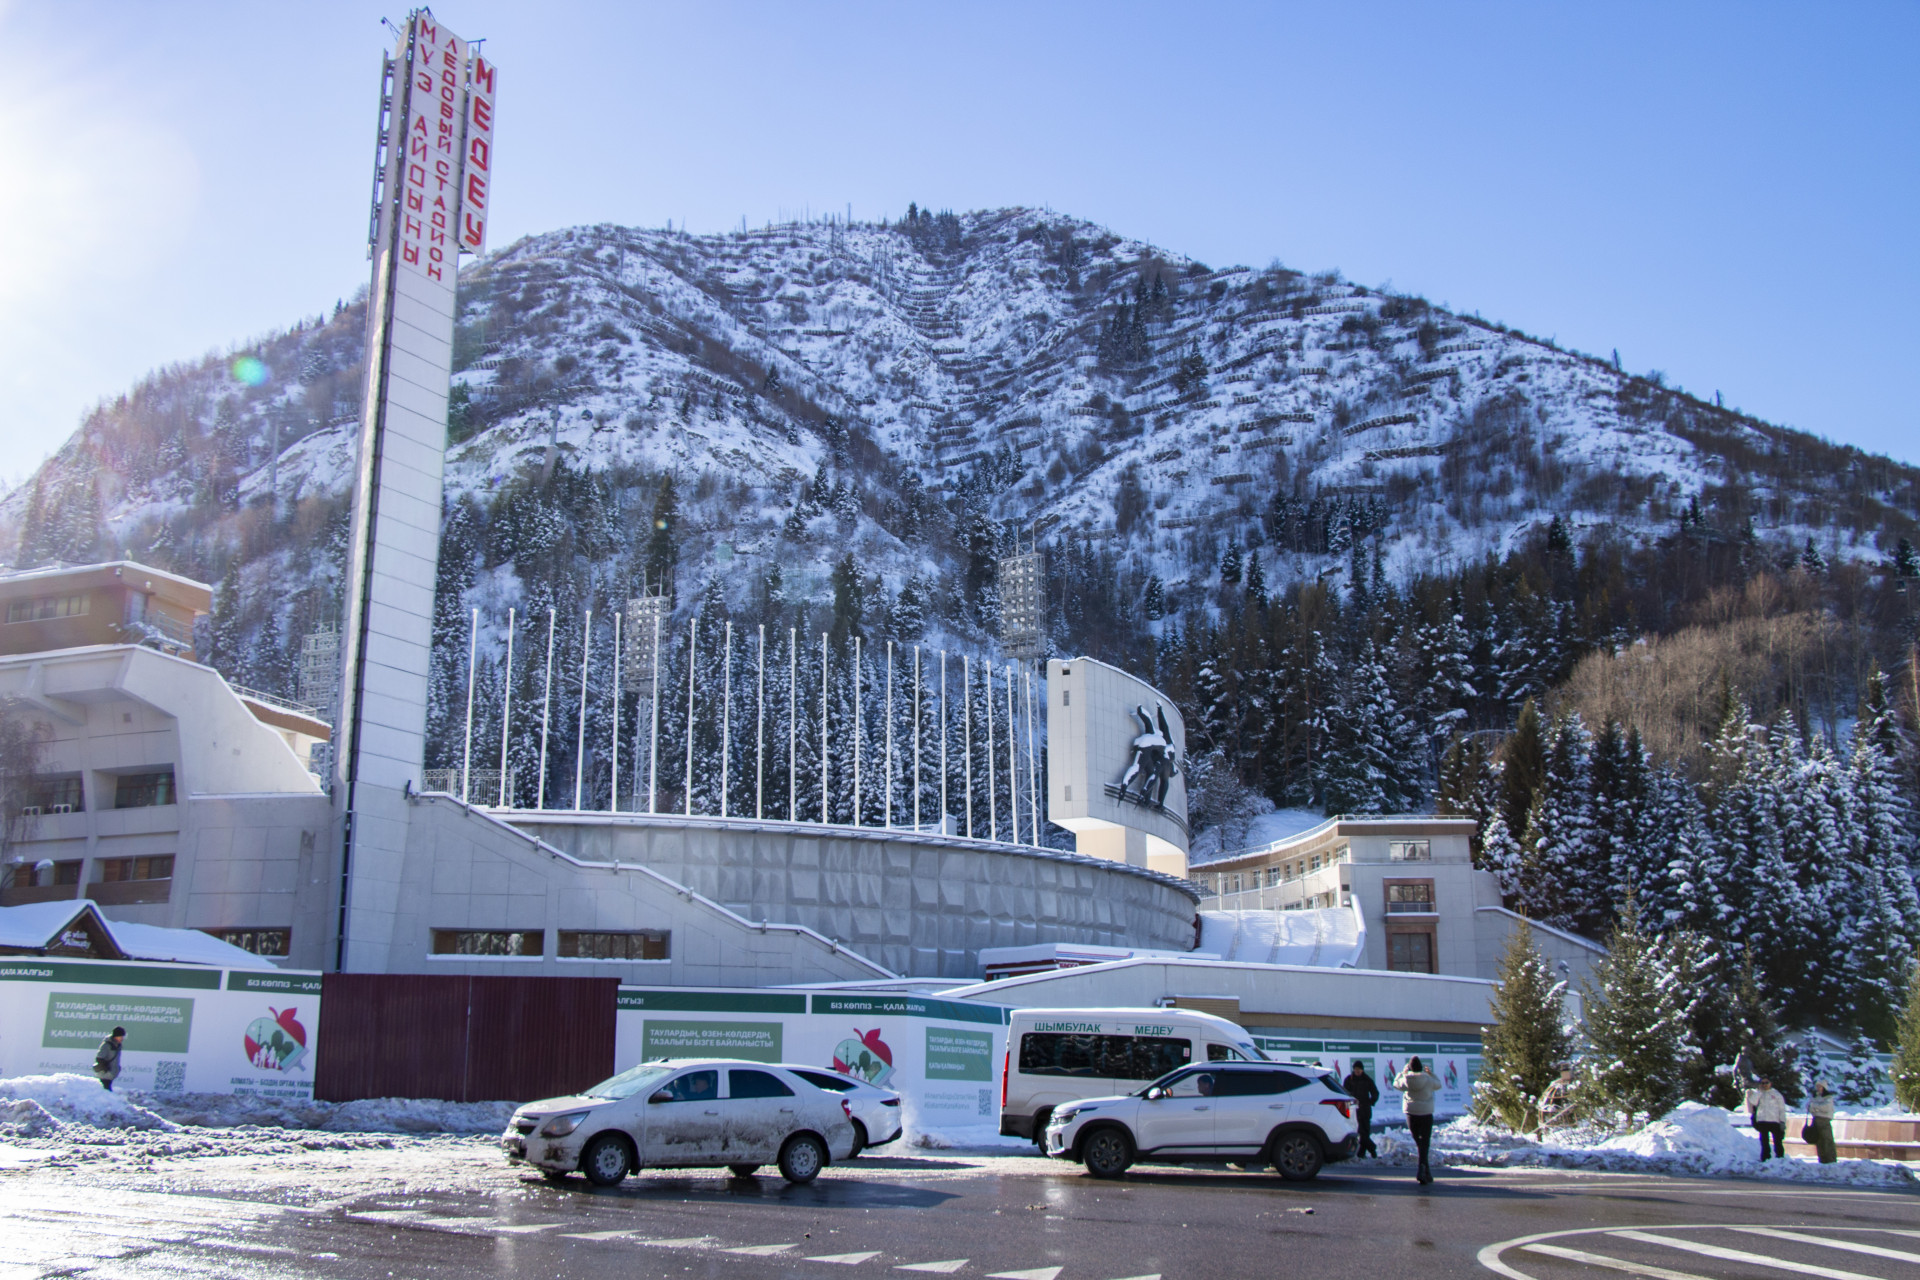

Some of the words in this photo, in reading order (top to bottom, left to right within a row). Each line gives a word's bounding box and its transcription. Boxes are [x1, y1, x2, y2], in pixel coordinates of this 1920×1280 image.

[438, 38, 457, 154] ЛЕДОВЫЙ
[465, 57, 493, 246] МЕДЕУ
[403, 115, 428, 266] АЙДЫНЫ
[428, 160, 449, 281] СТАДИОН
[247, 979, 260, 987] БІЗ
[261, 980, 291, 988] КӨППІЗ
[844, 1002, 872, 1010] КӨППІЗ
[883, 1003, 904, 1011] ҚАЛА
[100, 1013, 122, 1021] БІЗГЕ
[1034, 1022, 1102, 1033] ШЫМБУЛАК
[1134, 1025, 1175, 1036] МЕДЕУ
[649, 1038, 693, 1046] ТАЗАЛЫҒЫ
[715, 1038, 774, 1047] БАЙЛАНЫСТЫ!
